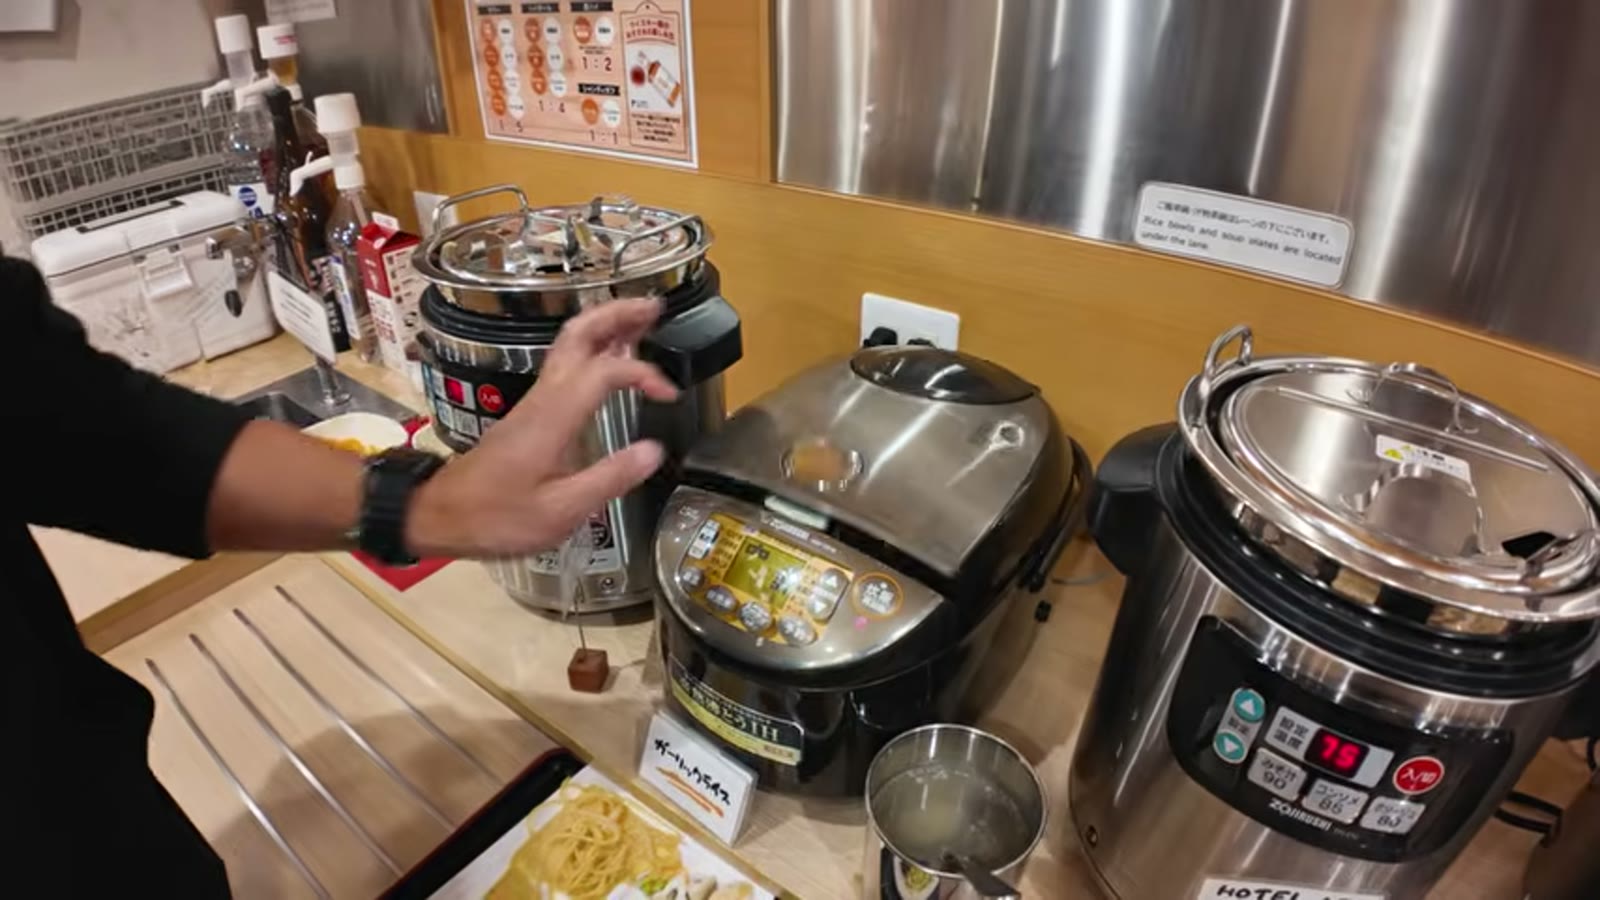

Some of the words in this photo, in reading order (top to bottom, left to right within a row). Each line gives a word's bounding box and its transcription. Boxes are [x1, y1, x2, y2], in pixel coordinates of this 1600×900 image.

[1141, 231, 1169, 245] under
[1170, 234, 1185, 247] the
[1143, 215, 1164, 228] Rice
[1167, 218, 1195, 234] bowls
[1199, 224, 1218, 239] and
[1221, 230, 1245, 245] soup
[1248, 233, 1279, 251] plates
[1282, 242, 1299, 256] are
[1303, 244, 1342, 266] located
[1279, 716, 1310, 740] 設定
[1273, 729, 1303, 752] 温度
[1321, 734, 1361, 770] 75
[653, 738, 731, 806] ガーリックライス
[1261, 759, 1297, 783] みそ汁
[1263, 770, 1287, 791] 90
[1401, 767, 1438, 784] 入/切
[1315, 783, 1360, 805] コンソメ
[1268, 797, 1332, 832] ZOJIRUSHI
[1318, 799, 1343, 815] 85
